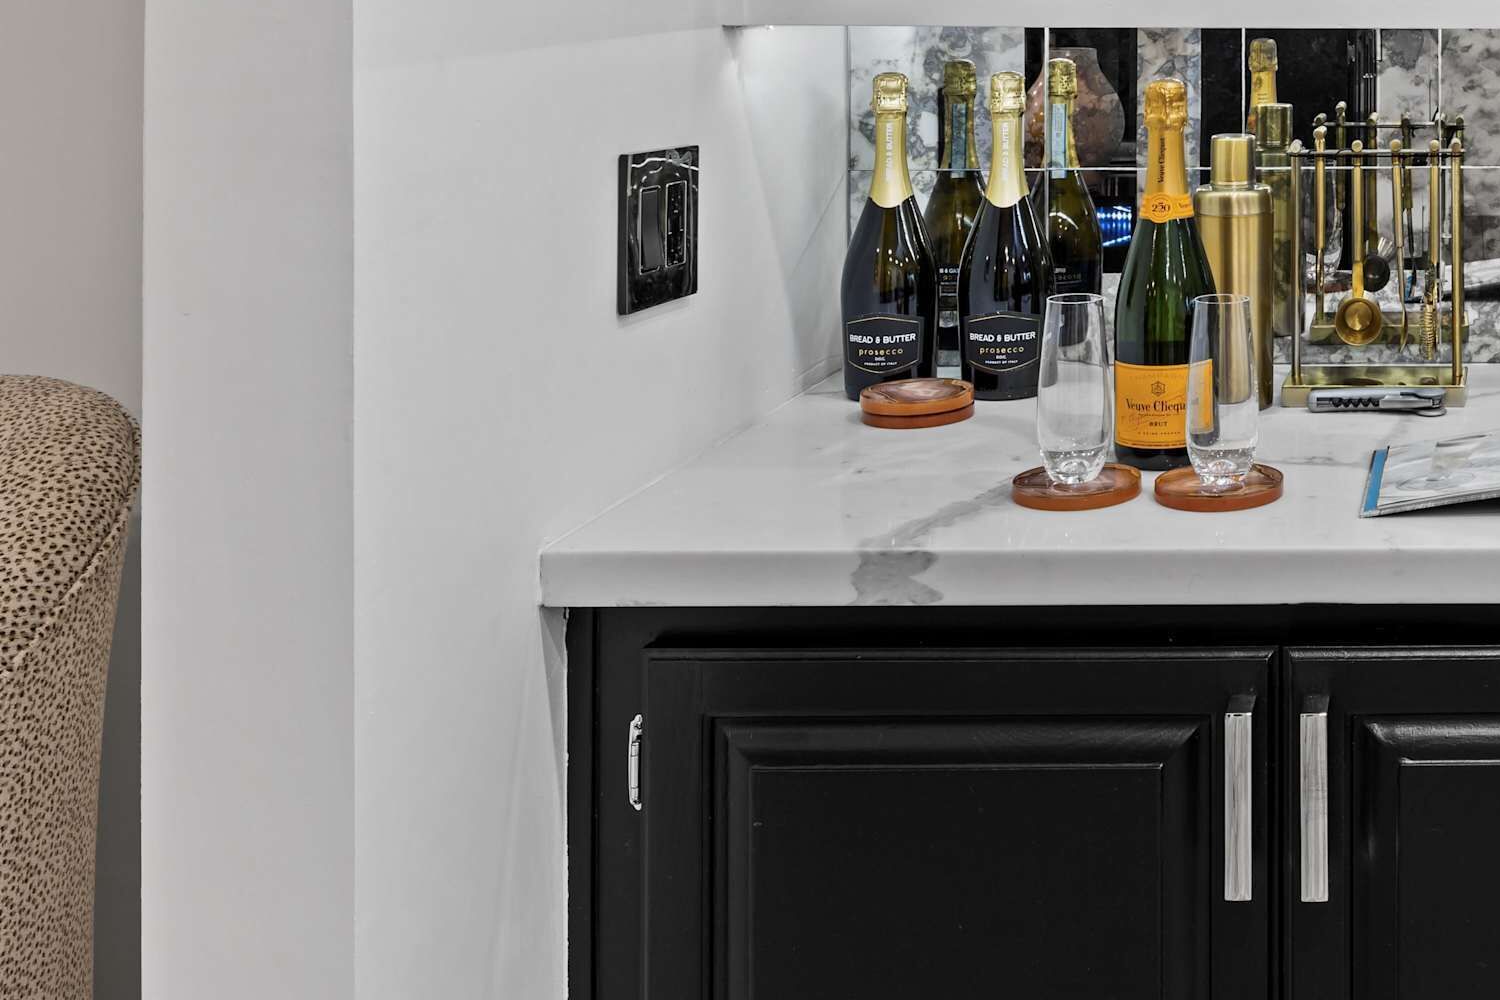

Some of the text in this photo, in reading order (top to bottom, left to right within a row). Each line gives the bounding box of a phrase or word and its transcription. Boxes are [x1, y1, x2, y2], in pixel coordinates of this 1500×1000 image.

[849, 334, 873, 344] BREAD
[882, 332, 916, 344] BUTTER
[969, 332, 995, 342] BREAD
[1003, 331, 1036, 342] BUTTER
[858, 348, 904, 356] prosecco
[979, 346, 1025, 355] prosecco
[1125, 398, 1151, 412] Veuve
